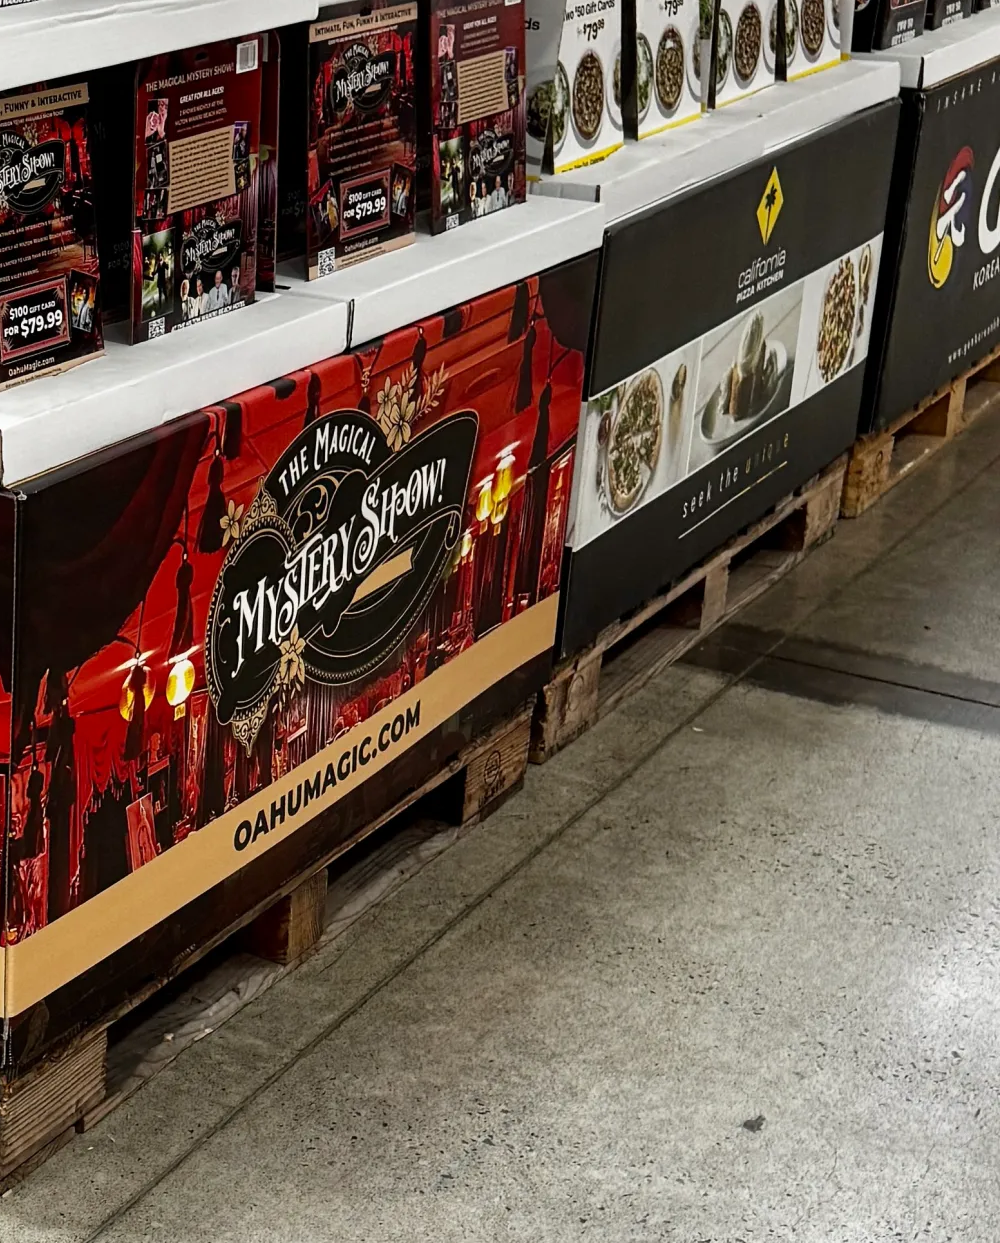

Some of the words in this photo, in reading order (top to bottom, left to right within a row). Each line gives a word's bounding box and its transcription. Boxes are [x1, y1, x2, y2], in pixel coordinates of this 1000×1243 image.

[735, 286, 755, 303] PIZZA
[756, 269, 785, 293] KITCHEN
[738, 247, 786, 289] california
[278, 450, 309, 497] THE
[313, 422, 377, 470] MAGICAL
[682, 481, 712, 518] seek
[719, 467, 738, 492] the
[231, 526, 356, 680] MYSTERY
[352, 457, 447, 576] SHOW!
[232, 699, 422, 852] OAHUMAGIC.COM
